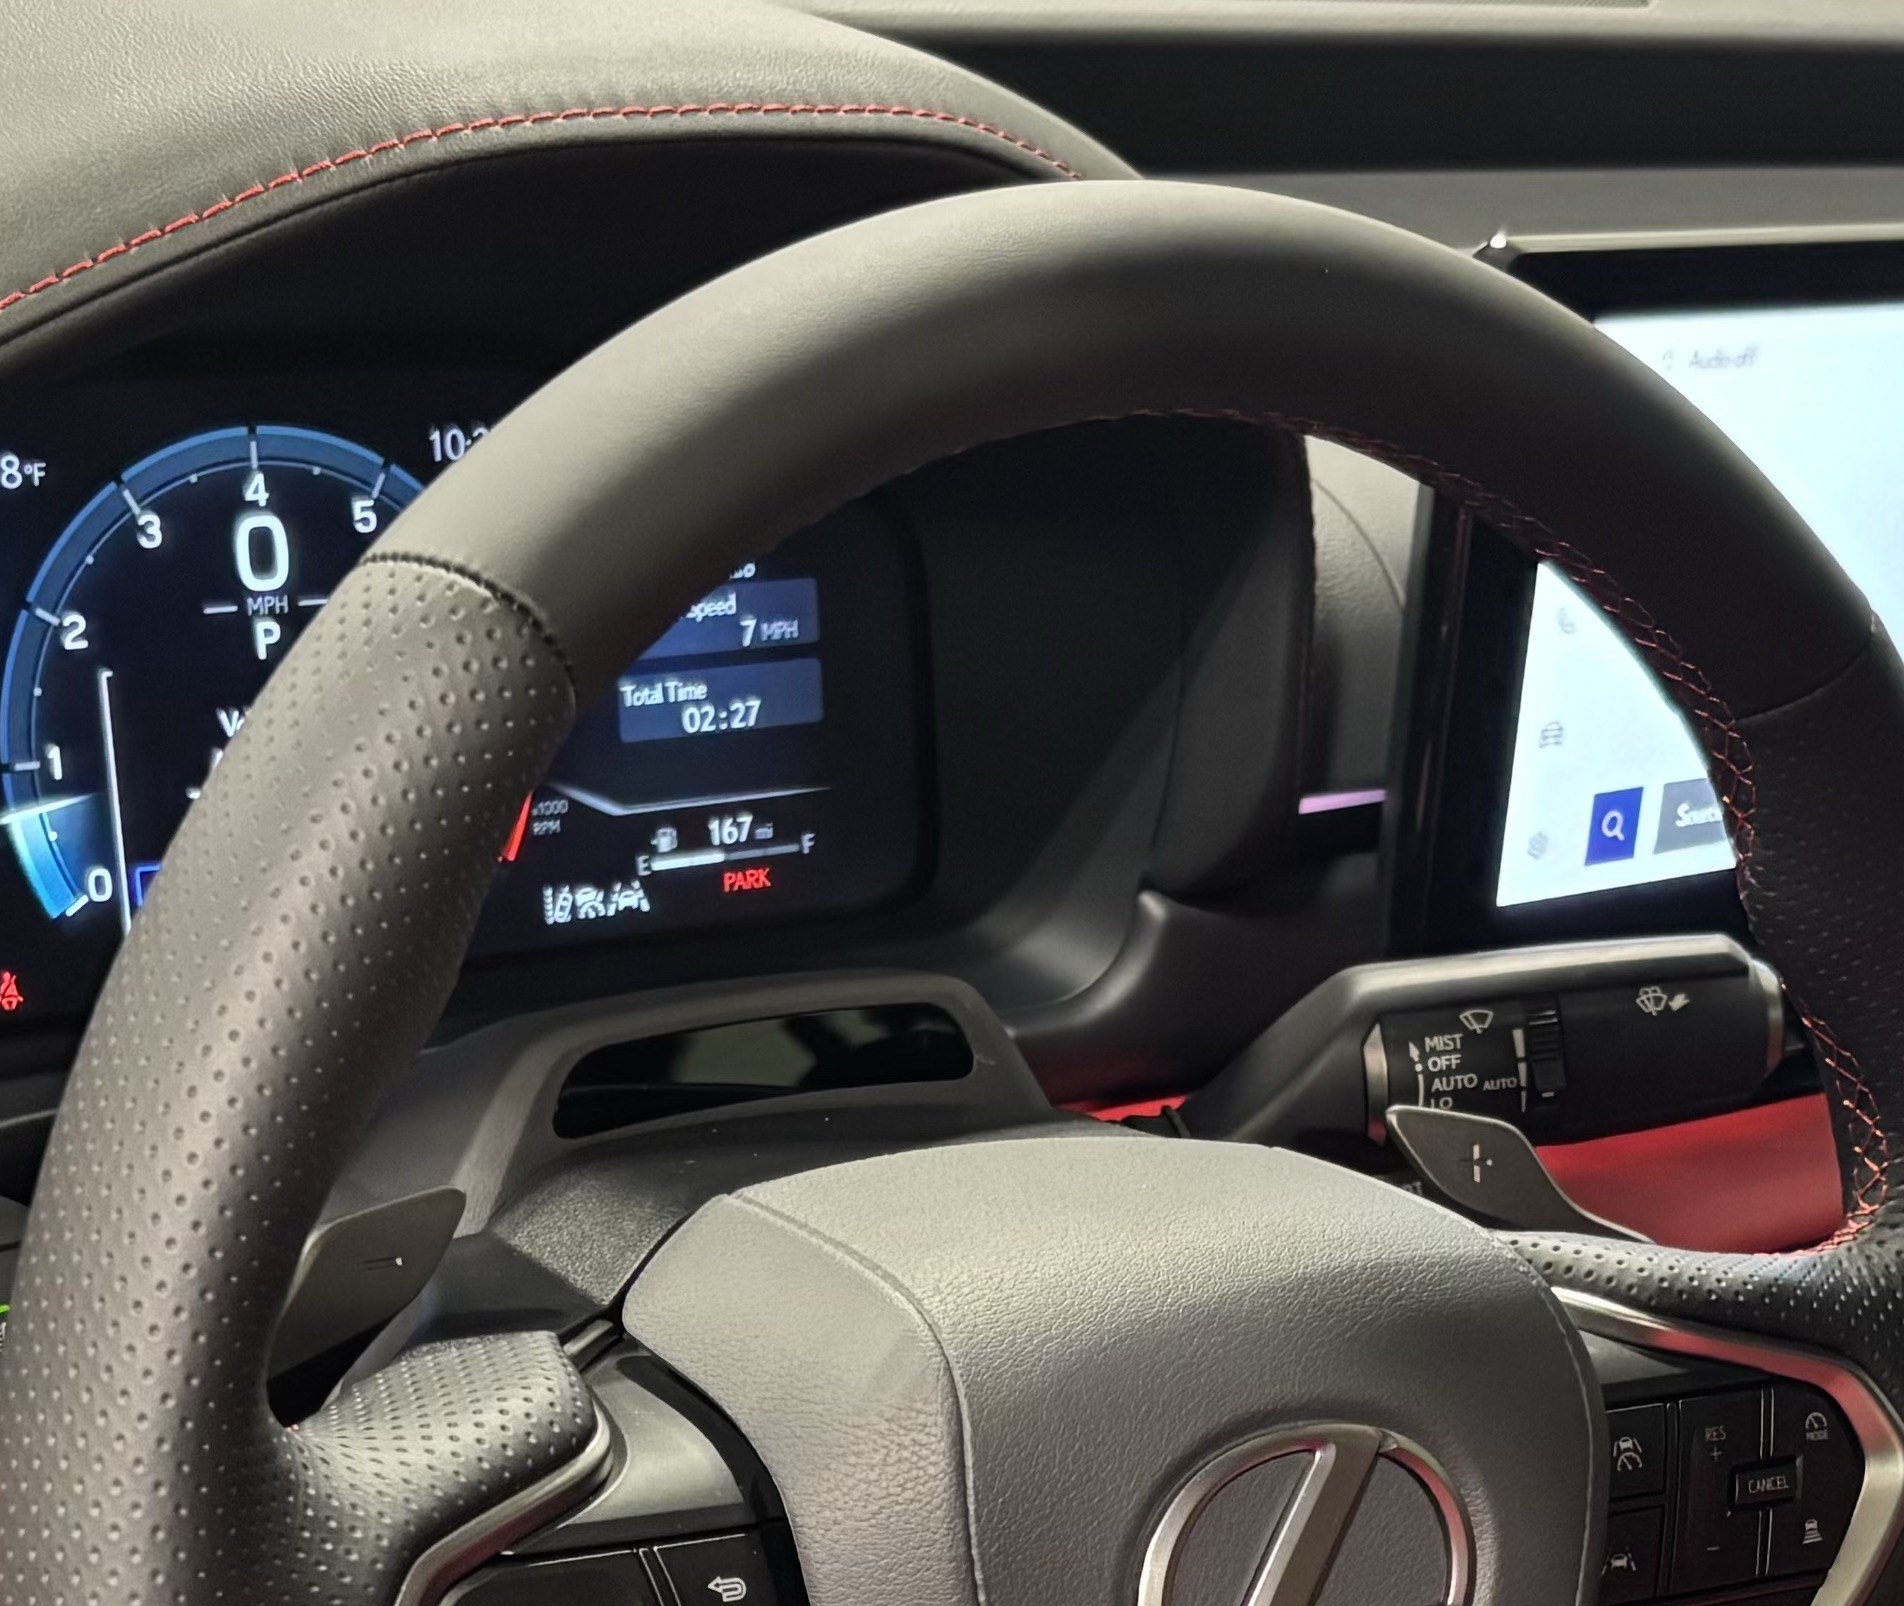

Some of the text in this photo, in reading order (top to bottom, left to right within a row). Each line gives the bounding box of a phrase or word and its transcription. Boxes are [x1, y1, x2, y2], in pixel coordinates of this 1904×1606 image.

[243, 474, 269, 507] 4
[136, 510, 163, 549] 3
[350, 497, 377, 534] 5
[234, 512, 290, 592] 0
[246, 595, 290, 617] MPH
[62, 613, 88, 650] 2
[252, 618, 281, 660] P
[739, 615, 758, 647] 7
[620, 679, 708, 707] Total Time
[681, 700, 762, 734] 02:27
[48, 744, 63, 781] 1
[636, 832, 816, 876] E F
[87, 866, 113, 902] 0
[723, 867, 771, 893] PARK
[1425, 1033, 1464, 1052] MIST
[1427, 1053, 1462, 1072] OFF
[1431, 1073, 1478, 1092] AUTO
[1482, 1076, 1518, 1091] AUTO
[1705, 1425, 1727, 1442] RES
[1747, 1475, 1790, 1494] CANCEL
